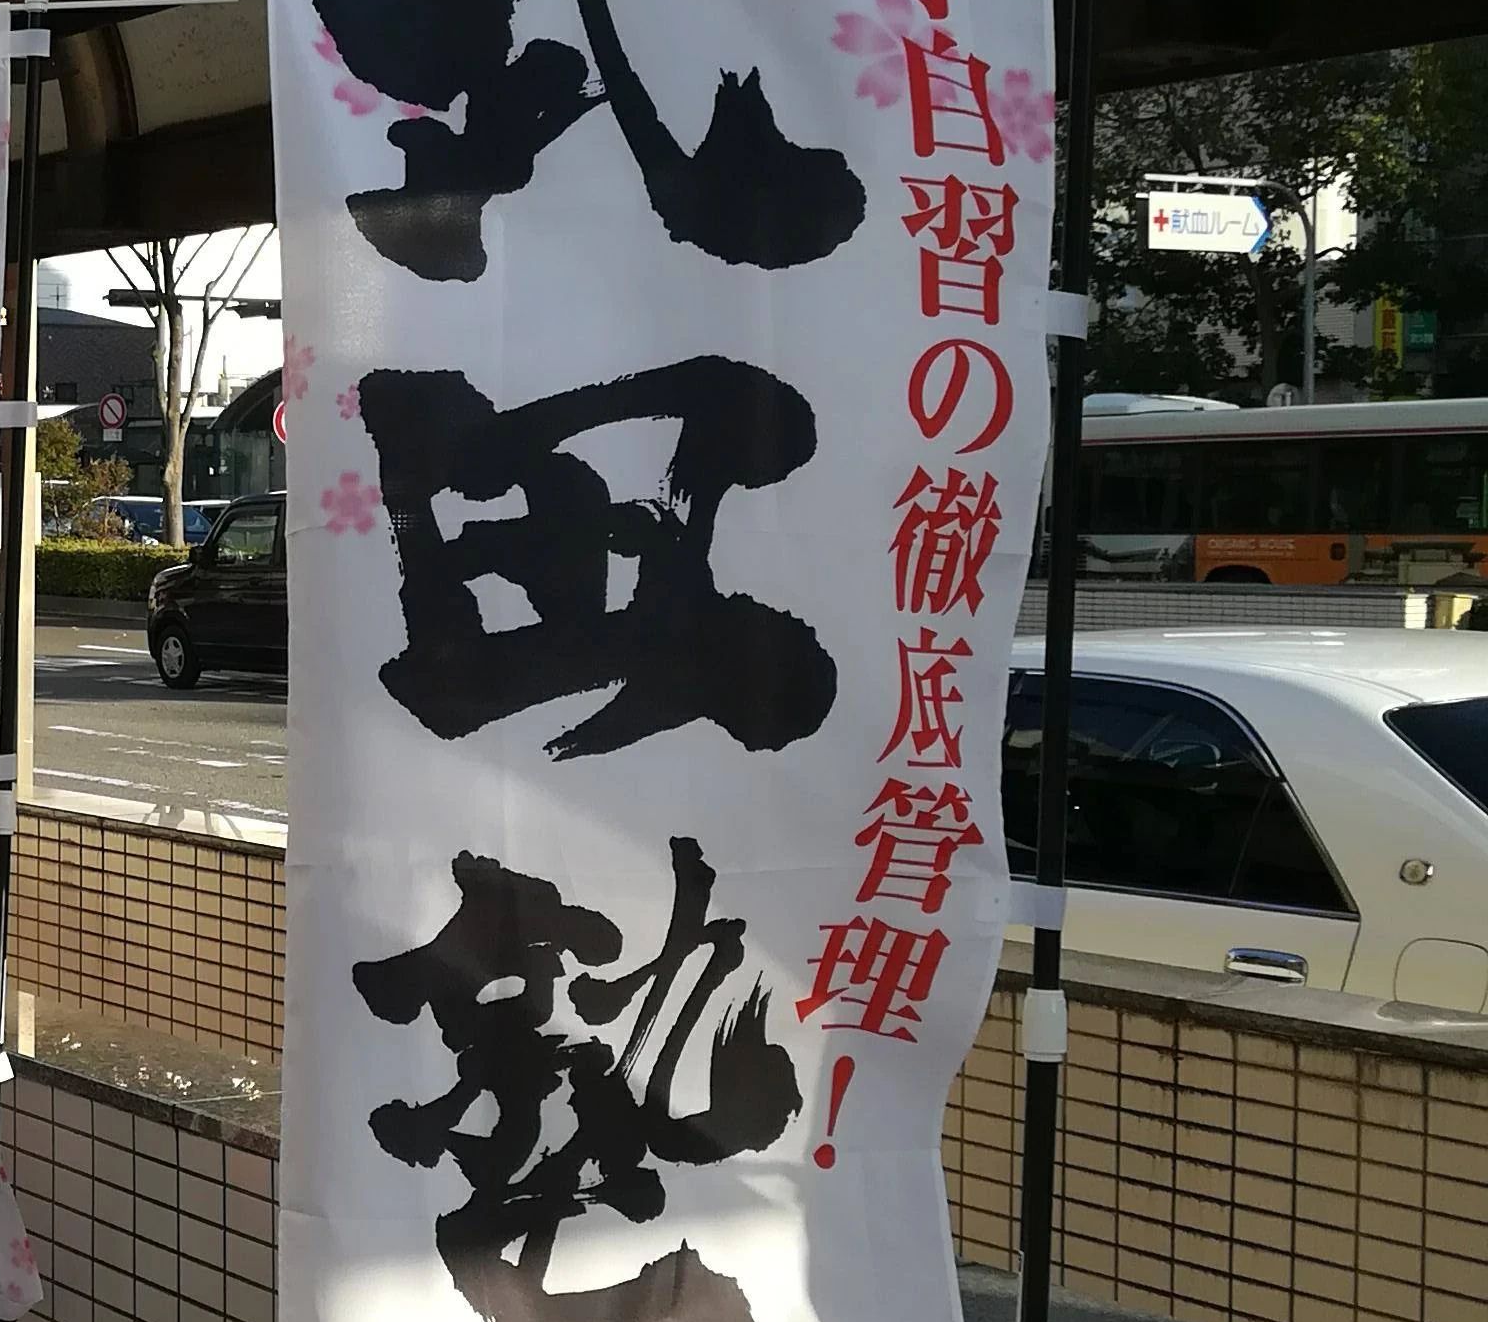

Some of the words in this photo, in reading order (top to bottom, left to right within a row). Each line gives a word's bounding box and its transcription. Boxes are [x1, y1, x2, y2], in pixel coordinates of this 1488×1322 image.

[1170, 208, 1260, 237] 献血ルーム
